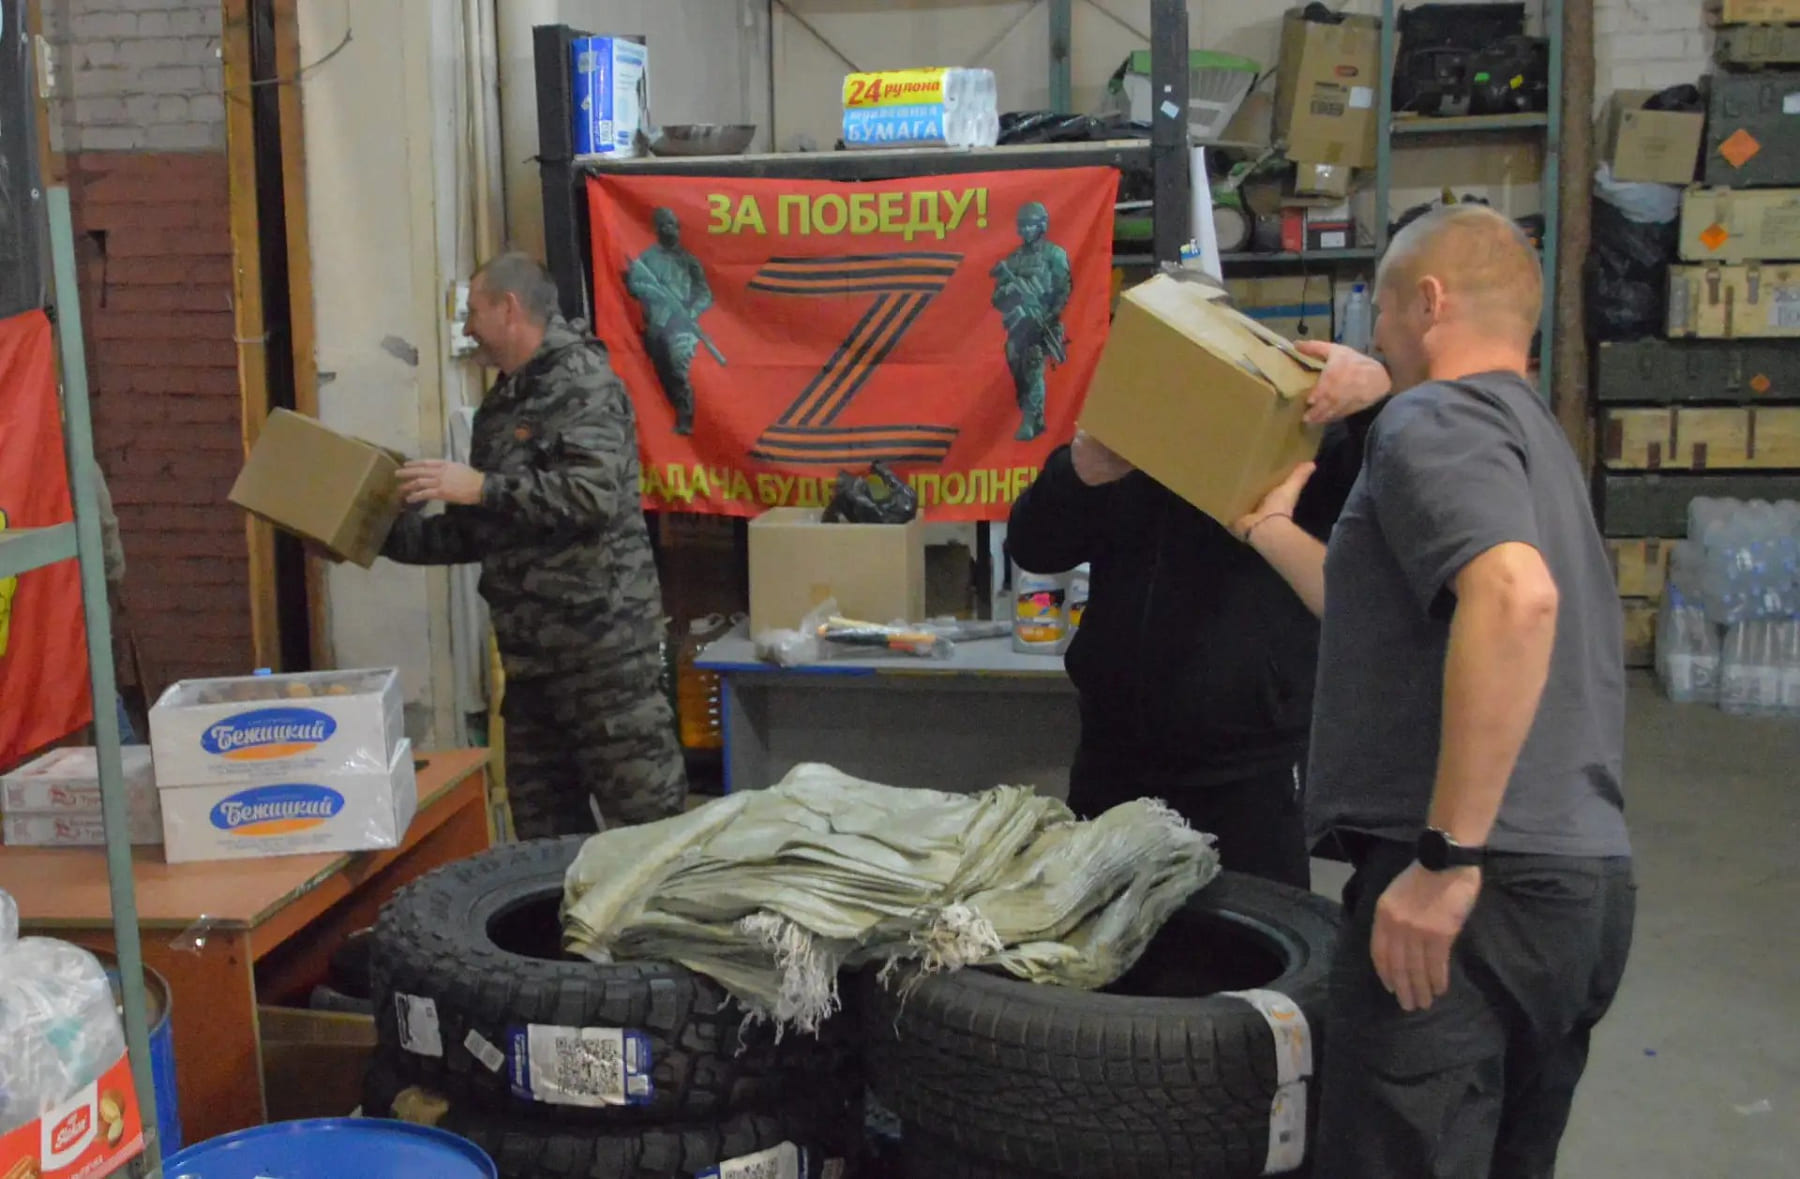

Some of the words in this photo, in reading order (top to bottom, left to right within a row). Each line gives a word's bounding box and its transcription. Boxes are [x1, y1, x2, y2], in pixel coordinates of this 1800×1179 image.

[848, 78, 883, 106] 24
[884, 80, 941, 98] рулона
[847, 119, 939, 143] БУМАГА
[706, 193, 768, 235] ЗА
[778, 187, 989, 242] ПОБЕДУ!
[747, 252, 965, 465] Z
[757, 472, 838, 506] БУДЕ
[210, 719, 326, 750] Бежицкий
[219, 795, 334, 826] Бежицкий
